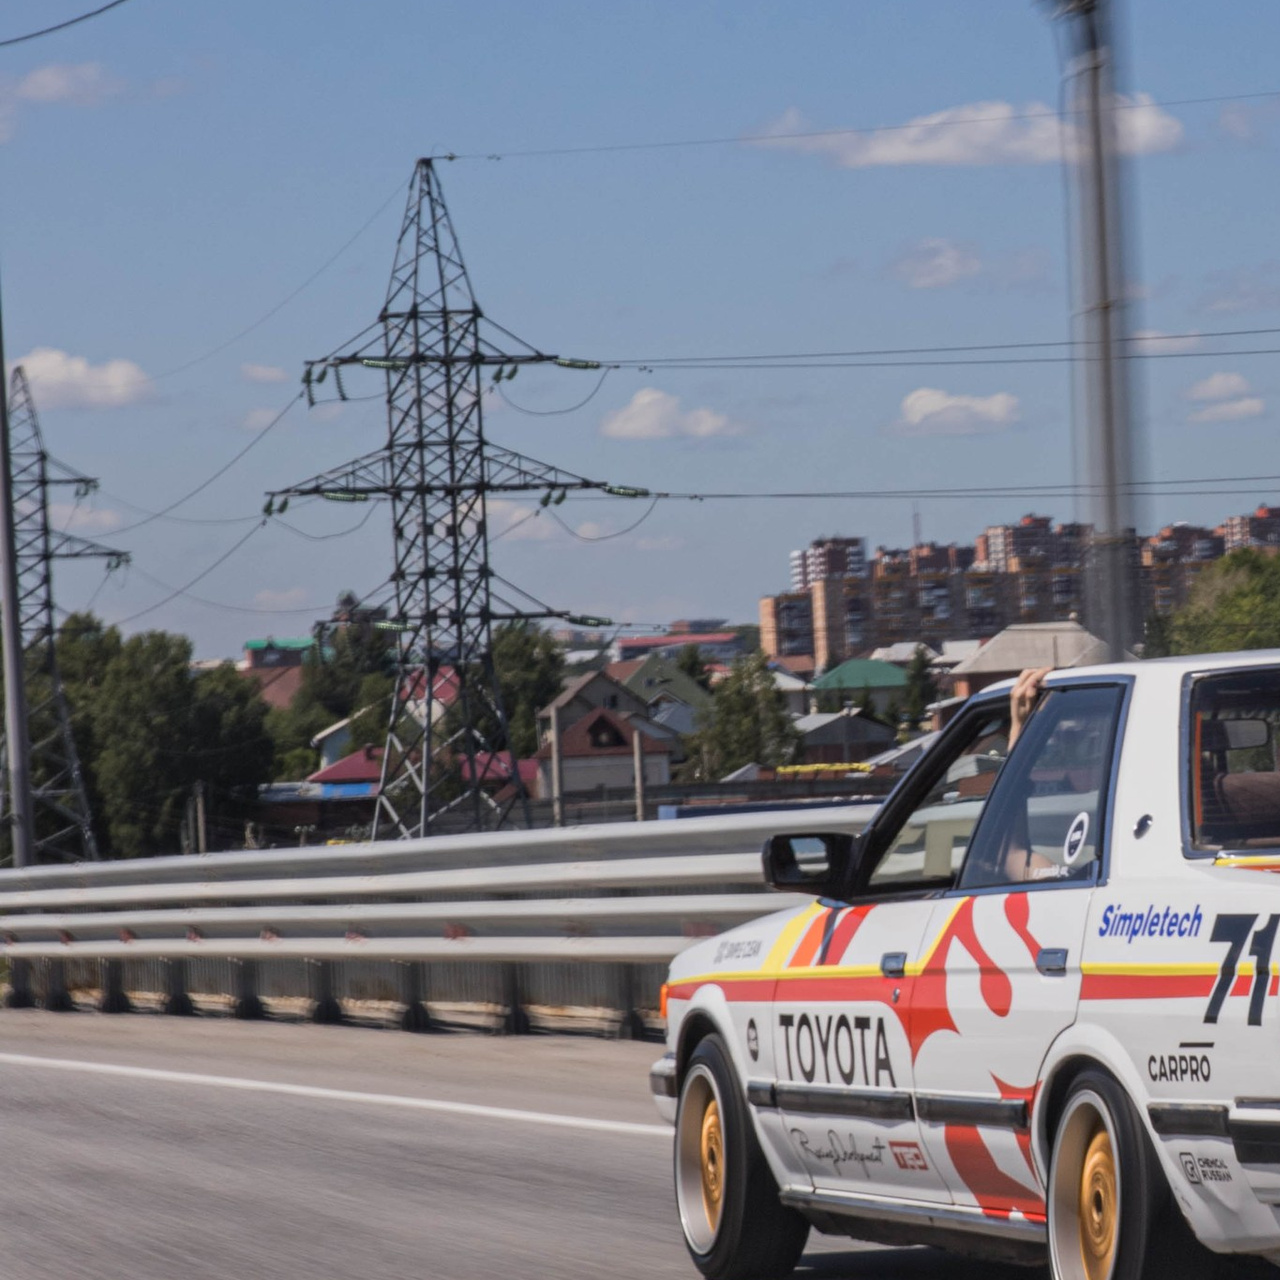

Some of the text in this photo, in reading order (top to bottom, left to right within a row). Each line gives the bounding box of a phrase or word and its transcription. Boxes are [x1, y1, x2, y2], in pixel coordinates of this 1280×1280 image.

[1098, 904, 1203, 945] Simpletech
[778, 1012, 897, 1089] TOYOTA
[1148, 1054, 1211, 1082] CARPRO
